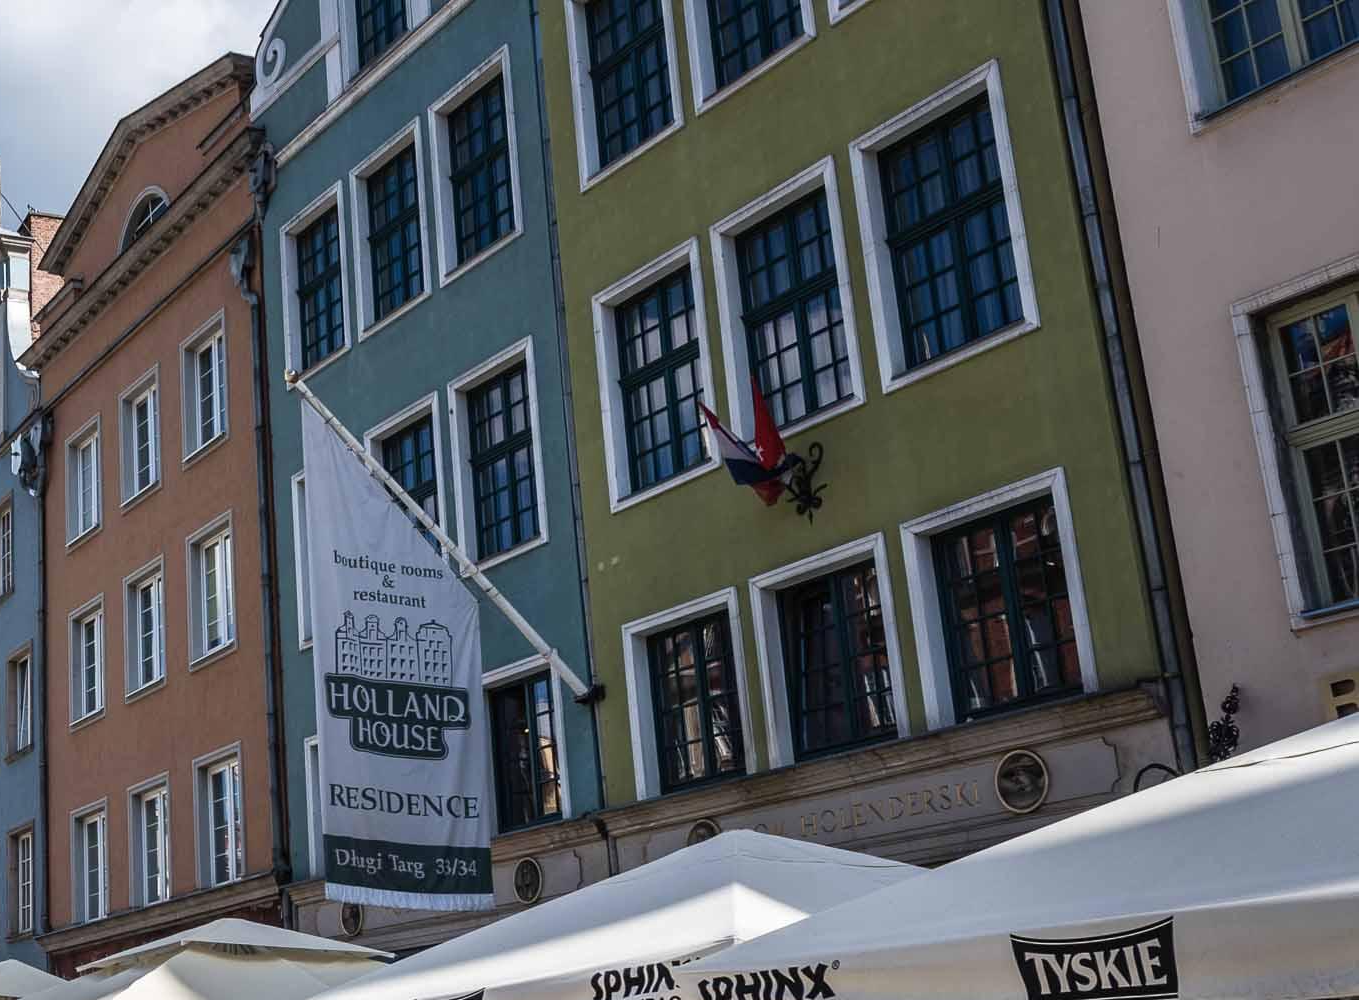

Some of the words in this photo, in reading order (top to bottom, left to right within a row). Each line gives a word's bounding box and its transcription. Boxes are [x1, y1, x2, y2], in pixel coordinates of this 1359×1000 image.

[333, 550, 396, 575] boutique
[401, 563, 444, 580] rooms
[382, 575, 395, 588] &
[353, 588, 426, 608] restaurant
[329, 682, 467, 723] HOLLAND
[357, 717, 443, 752] HOUSE
[329, 783, 480, 819] RESIDENCE
[799, 780, 982, 838] HOLENDERSKI
[388, 854, 426, 879] Targ
[435, 858, 478, 877] 33/34
[1024, 937, 1169, 995] TYSKIE
